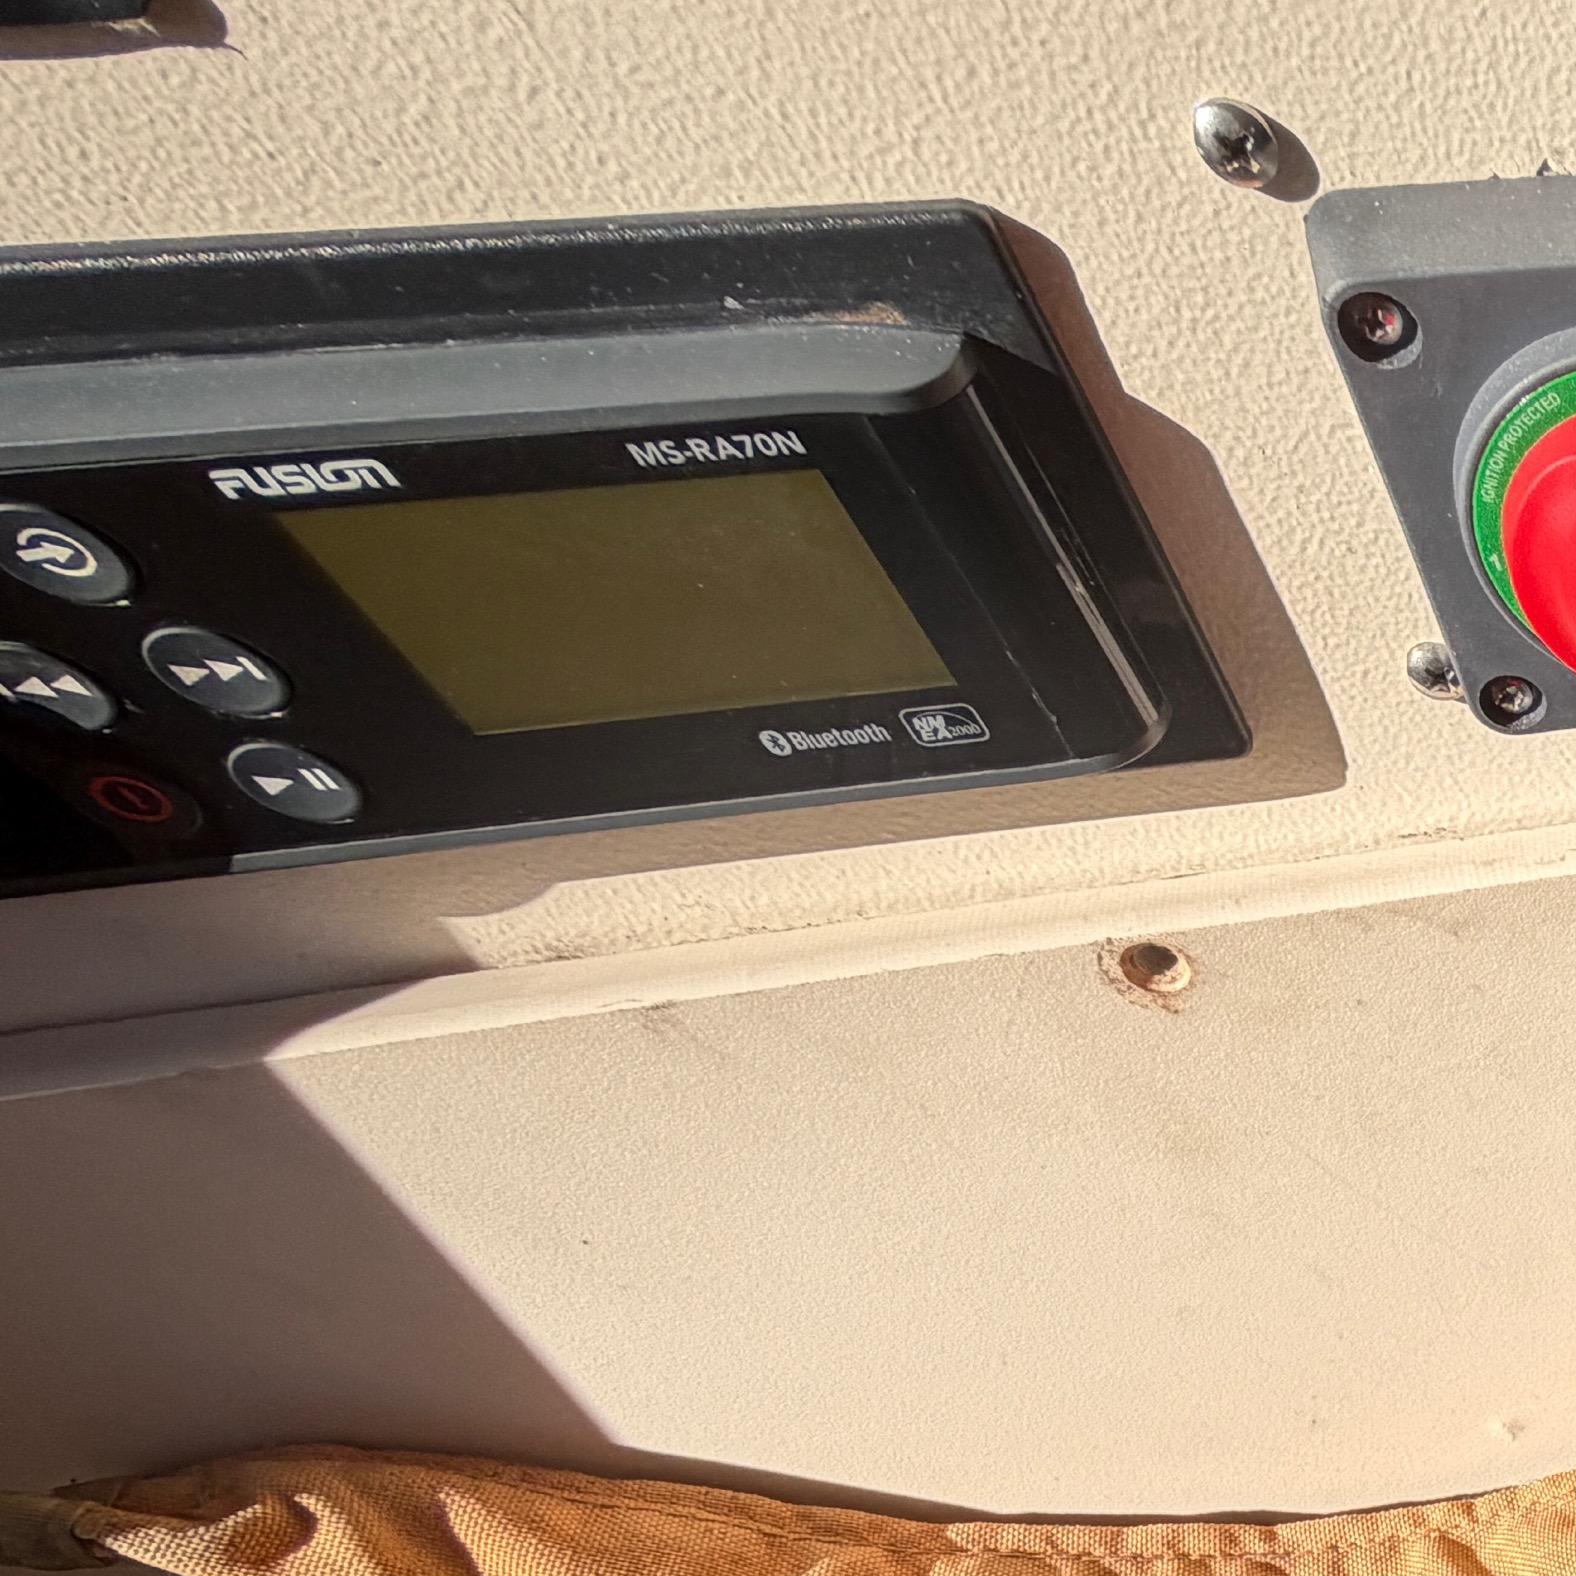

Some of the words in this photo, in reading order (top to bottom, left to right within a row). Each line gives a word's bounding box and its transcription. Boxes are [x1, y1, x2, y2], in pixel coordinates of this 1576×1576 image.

[625, 430, 808, 468] MS-RA70N
[1480, 449, 1509, 502] IGNITION
[1499, 392, 1561, 452] PROTECTED
[208, 458, 402, 500] FUSION
[788, 722, 893, 752] Bluetooth
